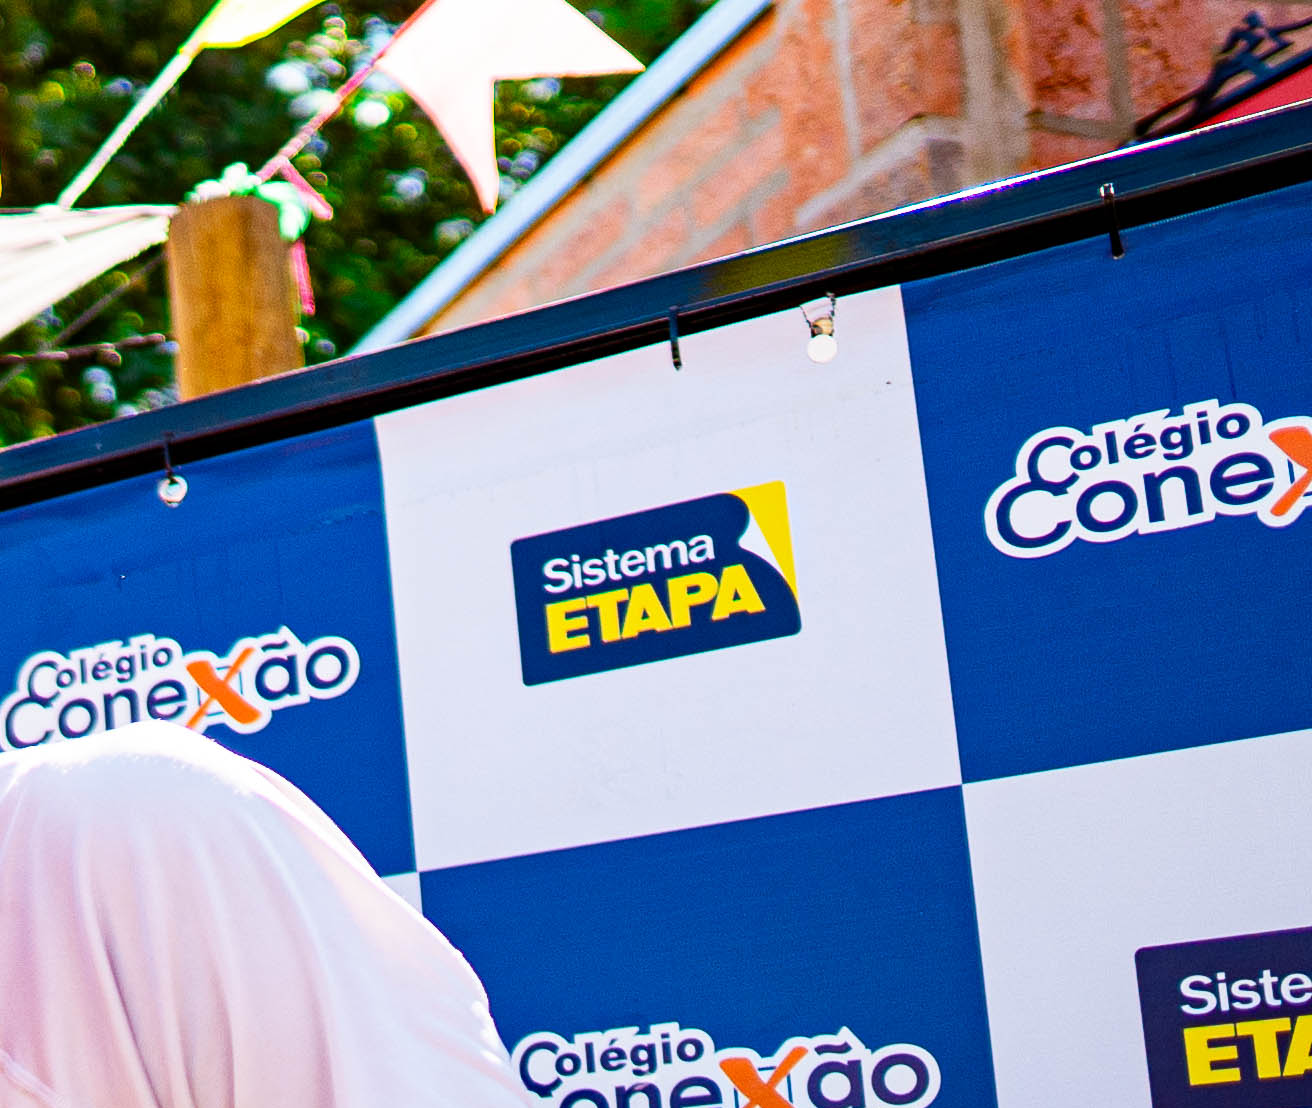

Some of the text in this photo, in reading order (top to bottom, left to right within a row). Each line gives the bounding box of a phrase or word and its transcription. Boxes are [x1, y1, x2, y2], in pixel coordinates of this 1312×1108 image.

[1027, 410, 1250, 490] Colégio
[996, 426, 1312, 549] Cone
[543, 534, 716, 594] Sistema
[545, 564, 766, 654] ETAPA
[28, 645, 173, 700] Colégio
[1180, 969, 1312, 1015] Siste
[519, 1033, 704, 1097] Colégio
